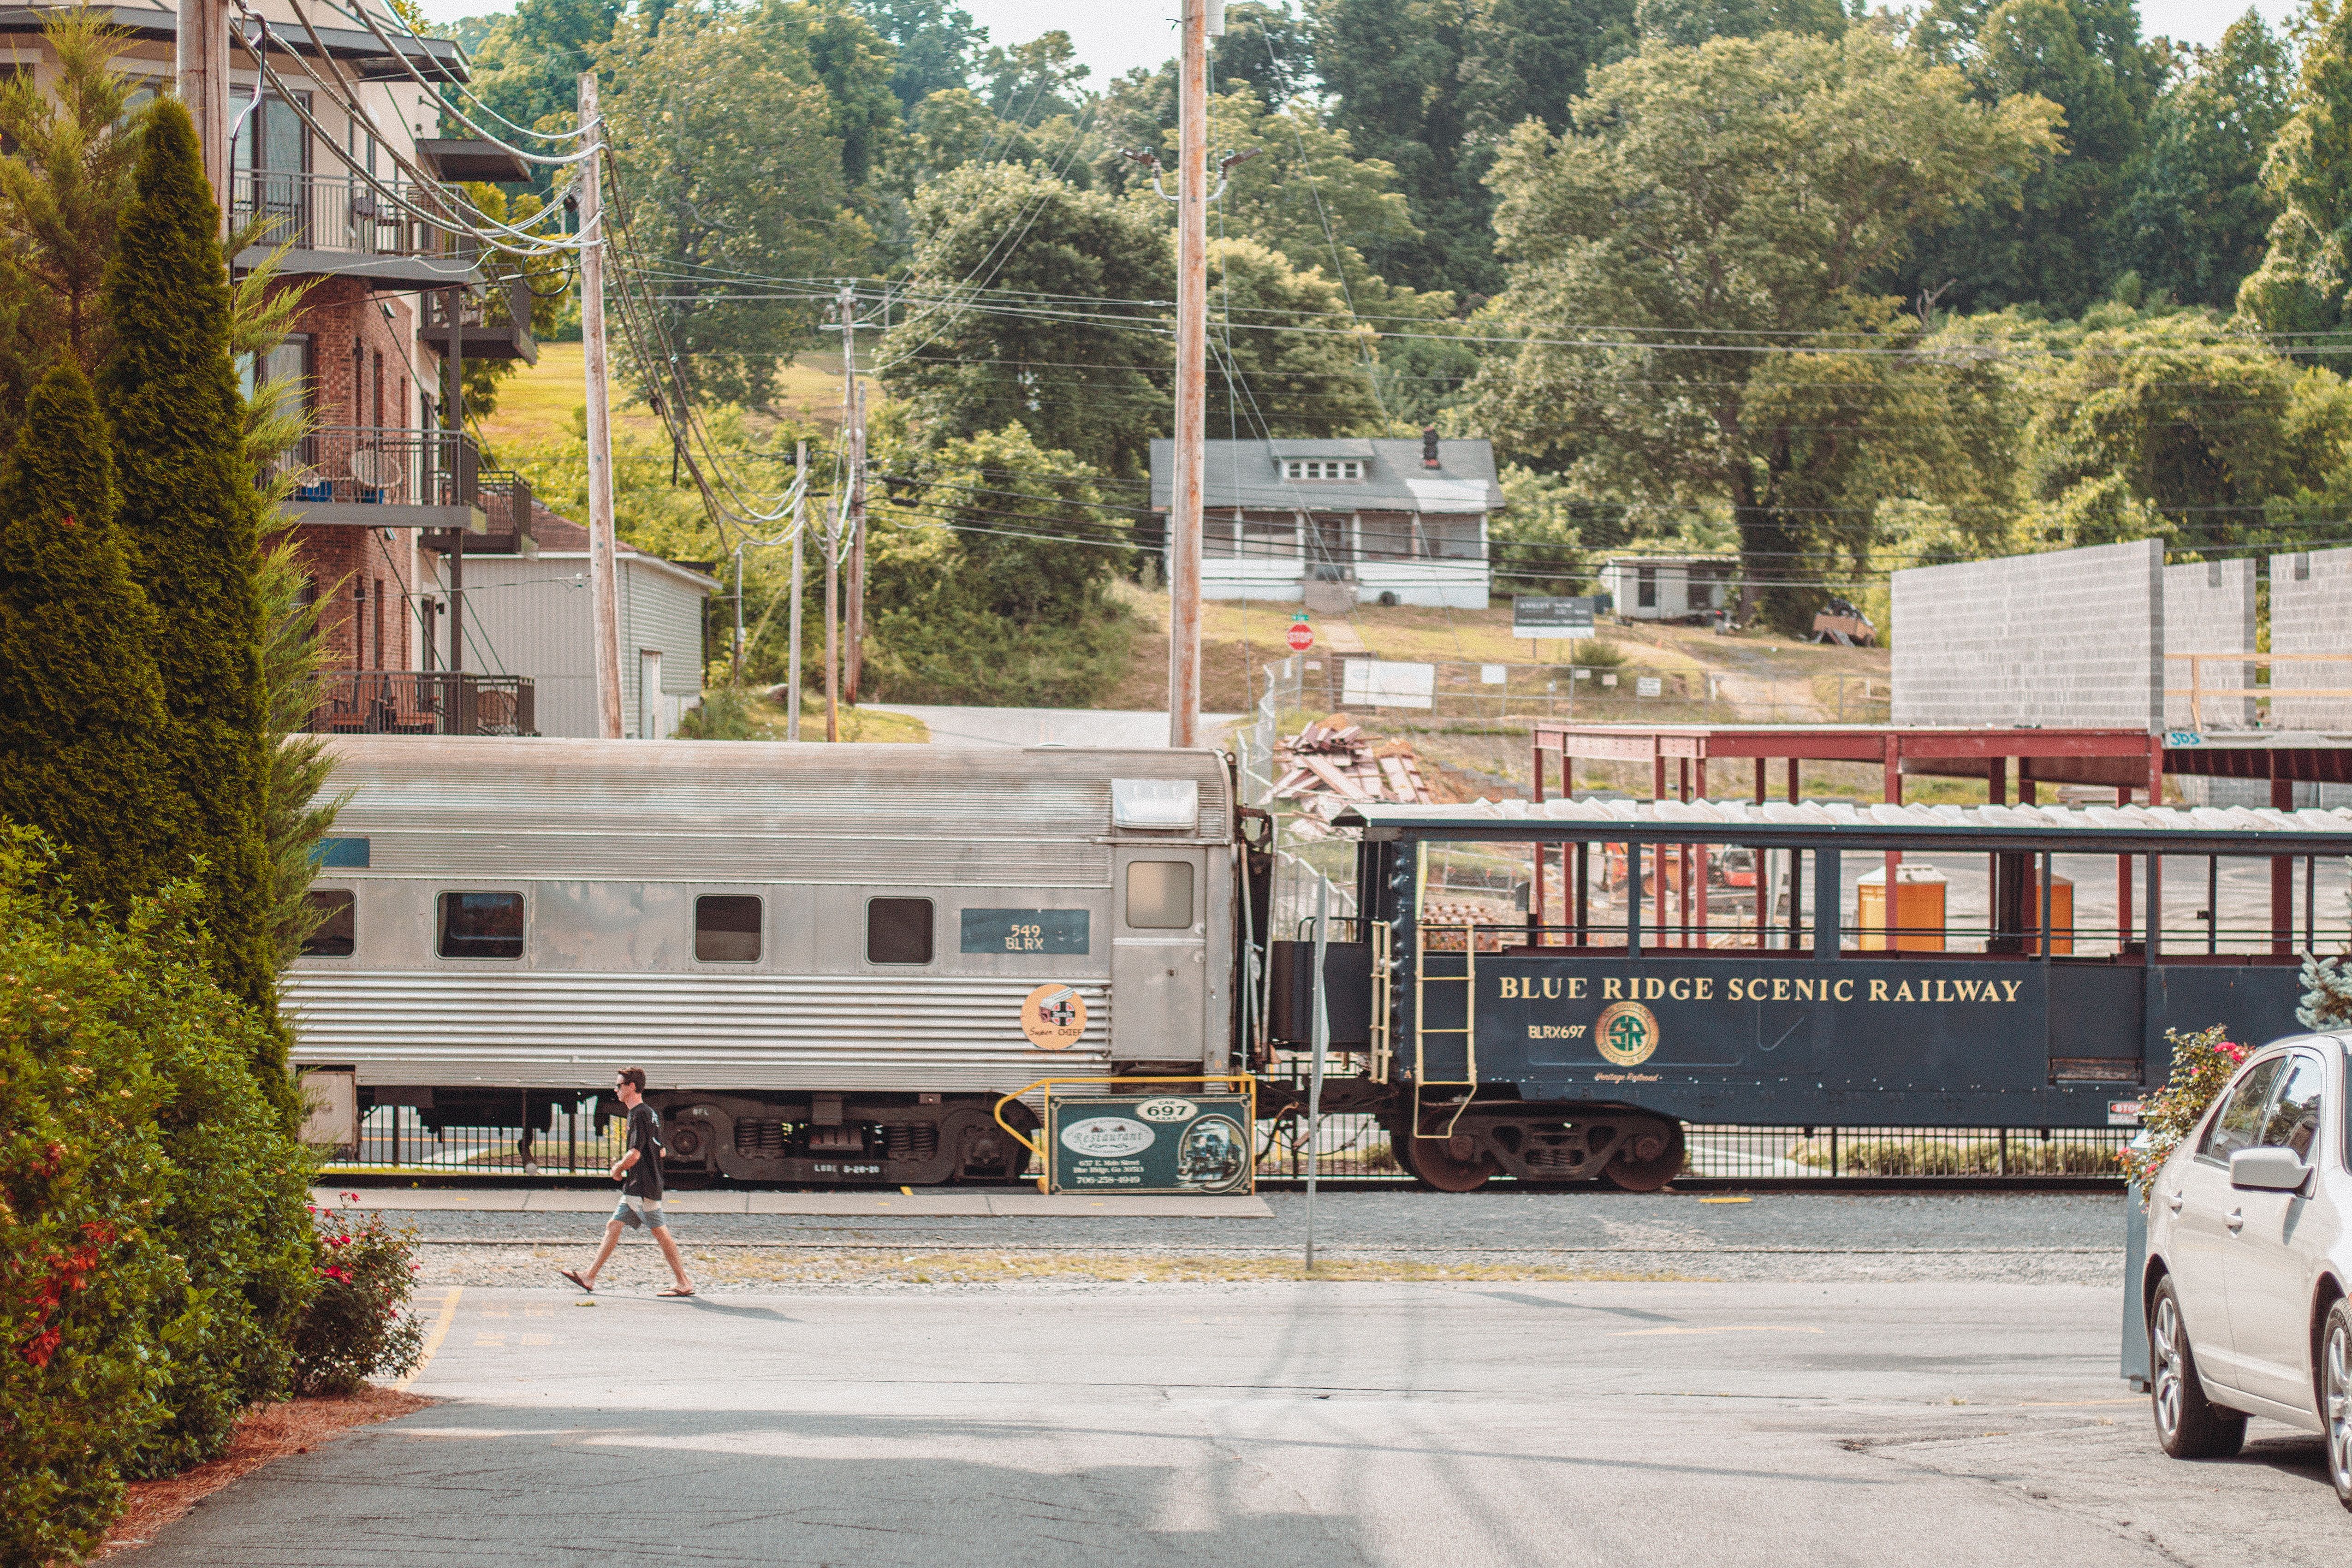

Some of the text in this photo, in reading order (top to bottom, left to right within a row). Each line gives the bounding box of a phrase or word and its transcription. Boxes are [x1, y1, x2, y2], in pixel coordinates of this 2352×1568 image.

[1288, 632, 1313, 643] STOP
[1011, 924, 1041, 938] 549
[1004, 937, 1044, 950] BLRX
[1499, 977, 2023, 1002] BLUE RIDGE SCENIC RAILWAY
[1029, 1027, 1052, 1036] Super
[1527, 1025, 1587, 1039] BLRX697
[1594, 1072, 1659, 1084] Heritage Railroad
[1147, 1106, 1188, 1116] 697
[1074, 1132, 1142, 1146] Restaurant
